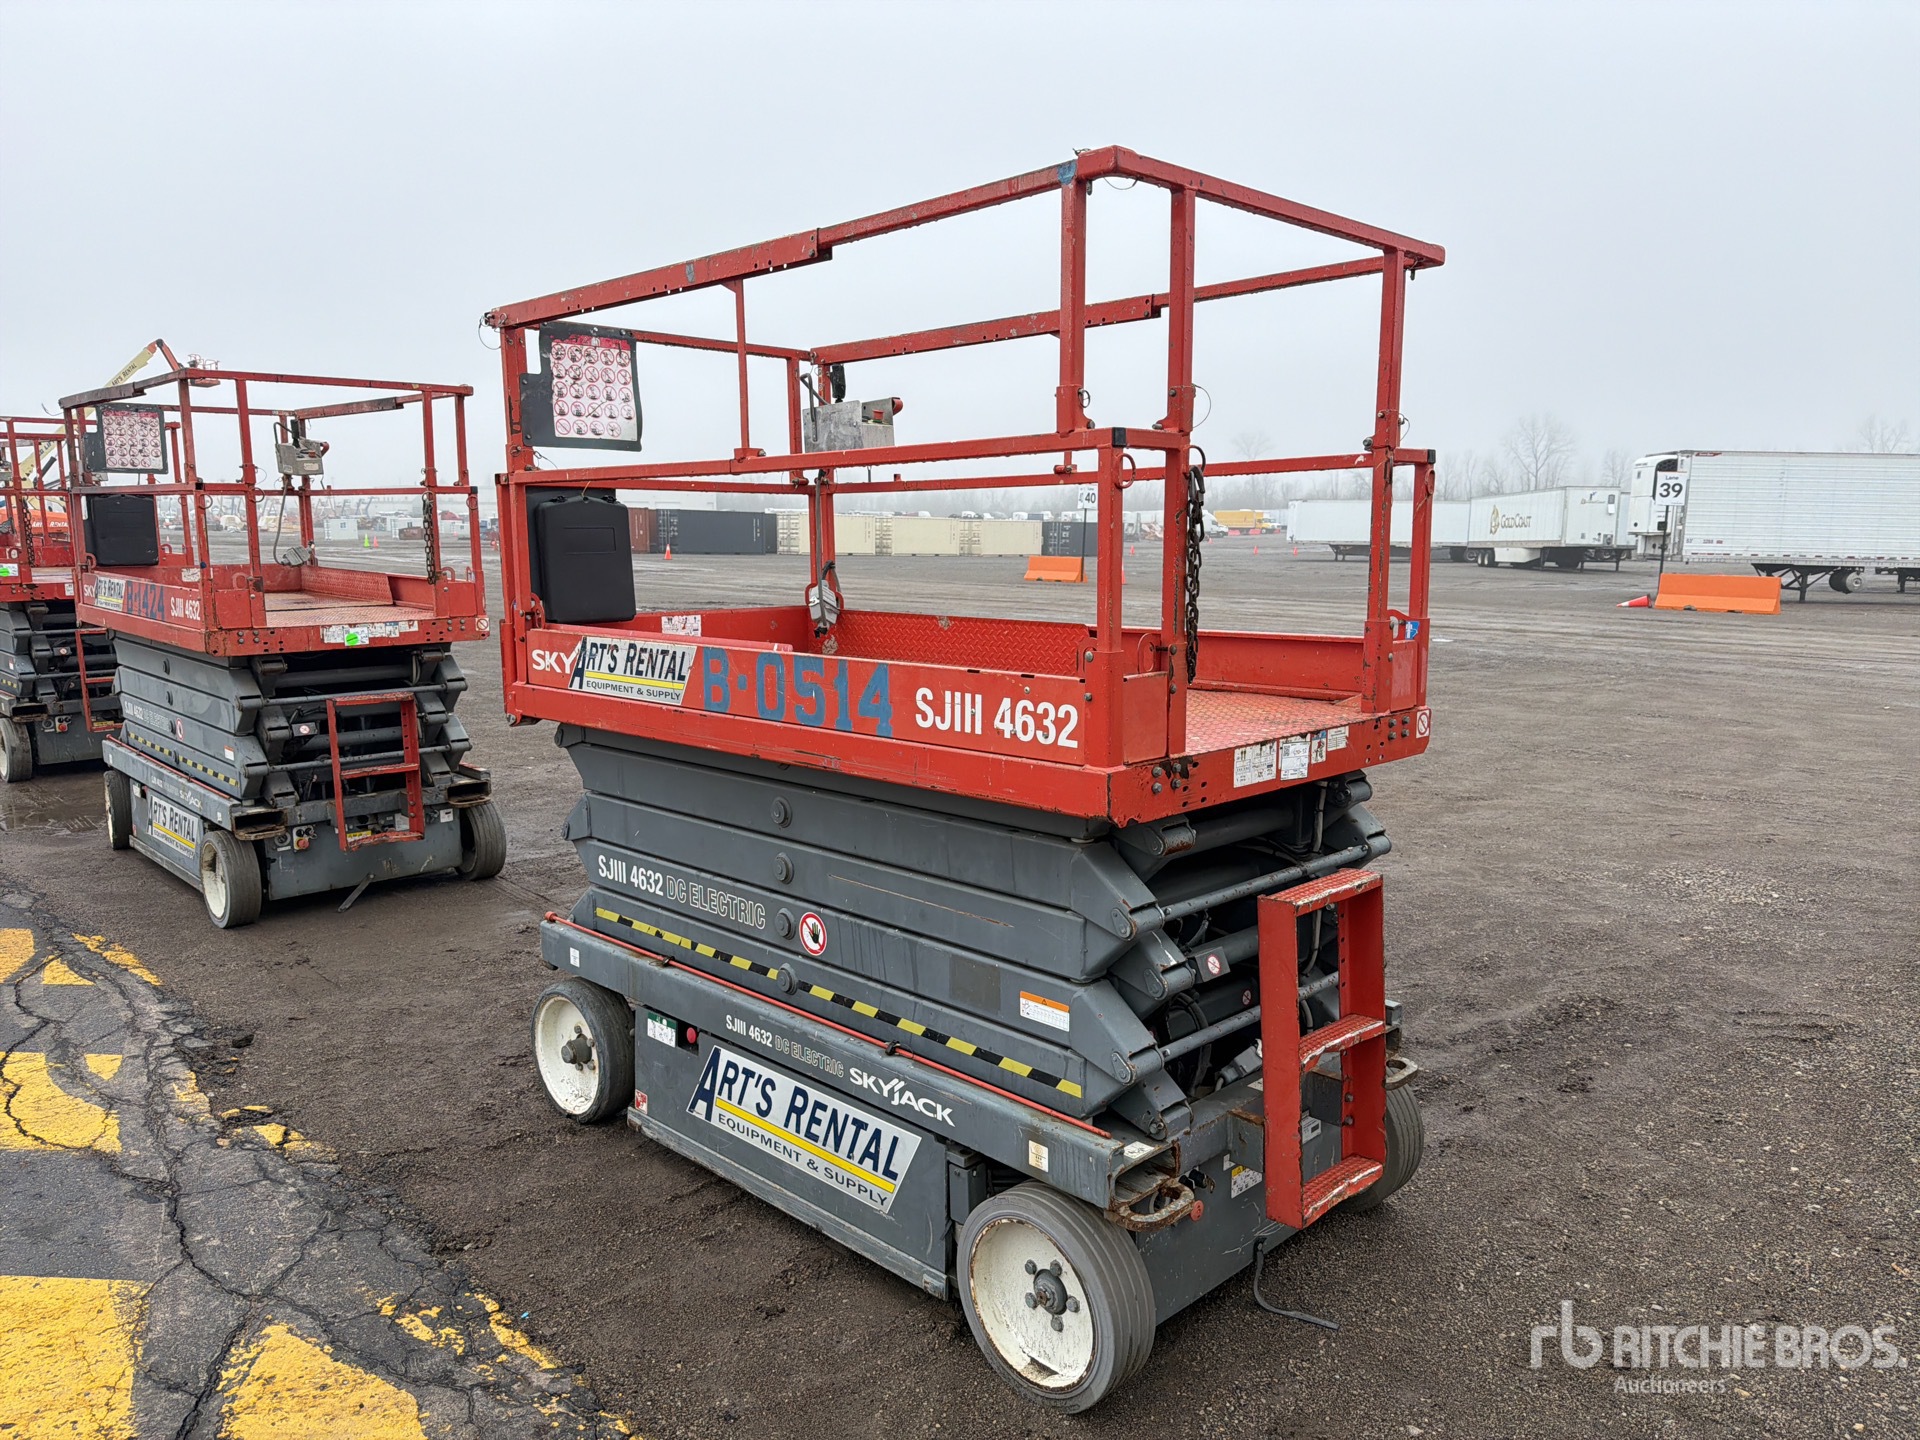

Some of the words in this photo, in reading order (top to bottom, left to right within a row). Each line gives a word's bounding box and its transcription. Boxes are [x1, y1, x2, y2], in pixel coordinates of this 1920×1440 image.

[1085, 492, 1096, 504] 40
[1659, 482, 1683, 498] 39
[185, 599, 201, 621] 4632
[568, 636, 619, 690] ART'S
[623, 642, 687, 682] RENTAL
[586, 680, 634, 695] EQUIPMENT
[636, 688, 645, 696] &
[646, 688, 681, 701] SUPPLY
[993, 697, 1079, 749] 4632
[169, 806, 196, 843] RENTAL
[630, 865, 664, 896] 4632
[666, 874, 687, 903] DC
[689, 882, 766, 930] ELECTRIC
[748, 1025, 773, 1048] 4632
[774, 1035, 790, 1055] DC
[790, 1042, 845, 1078] ELECTRIC
[688, 1047, 777, 1123] ART'S
[783, 1085, 900, 1181] RENTAL
[849, 1067, 956, 1128] SKYJACK
[718, 1113, 802, 1163] EQUIPMENT
[806, 1158, 820, 1173] &
[823, 1166, 888, 1207] SUPPLY
